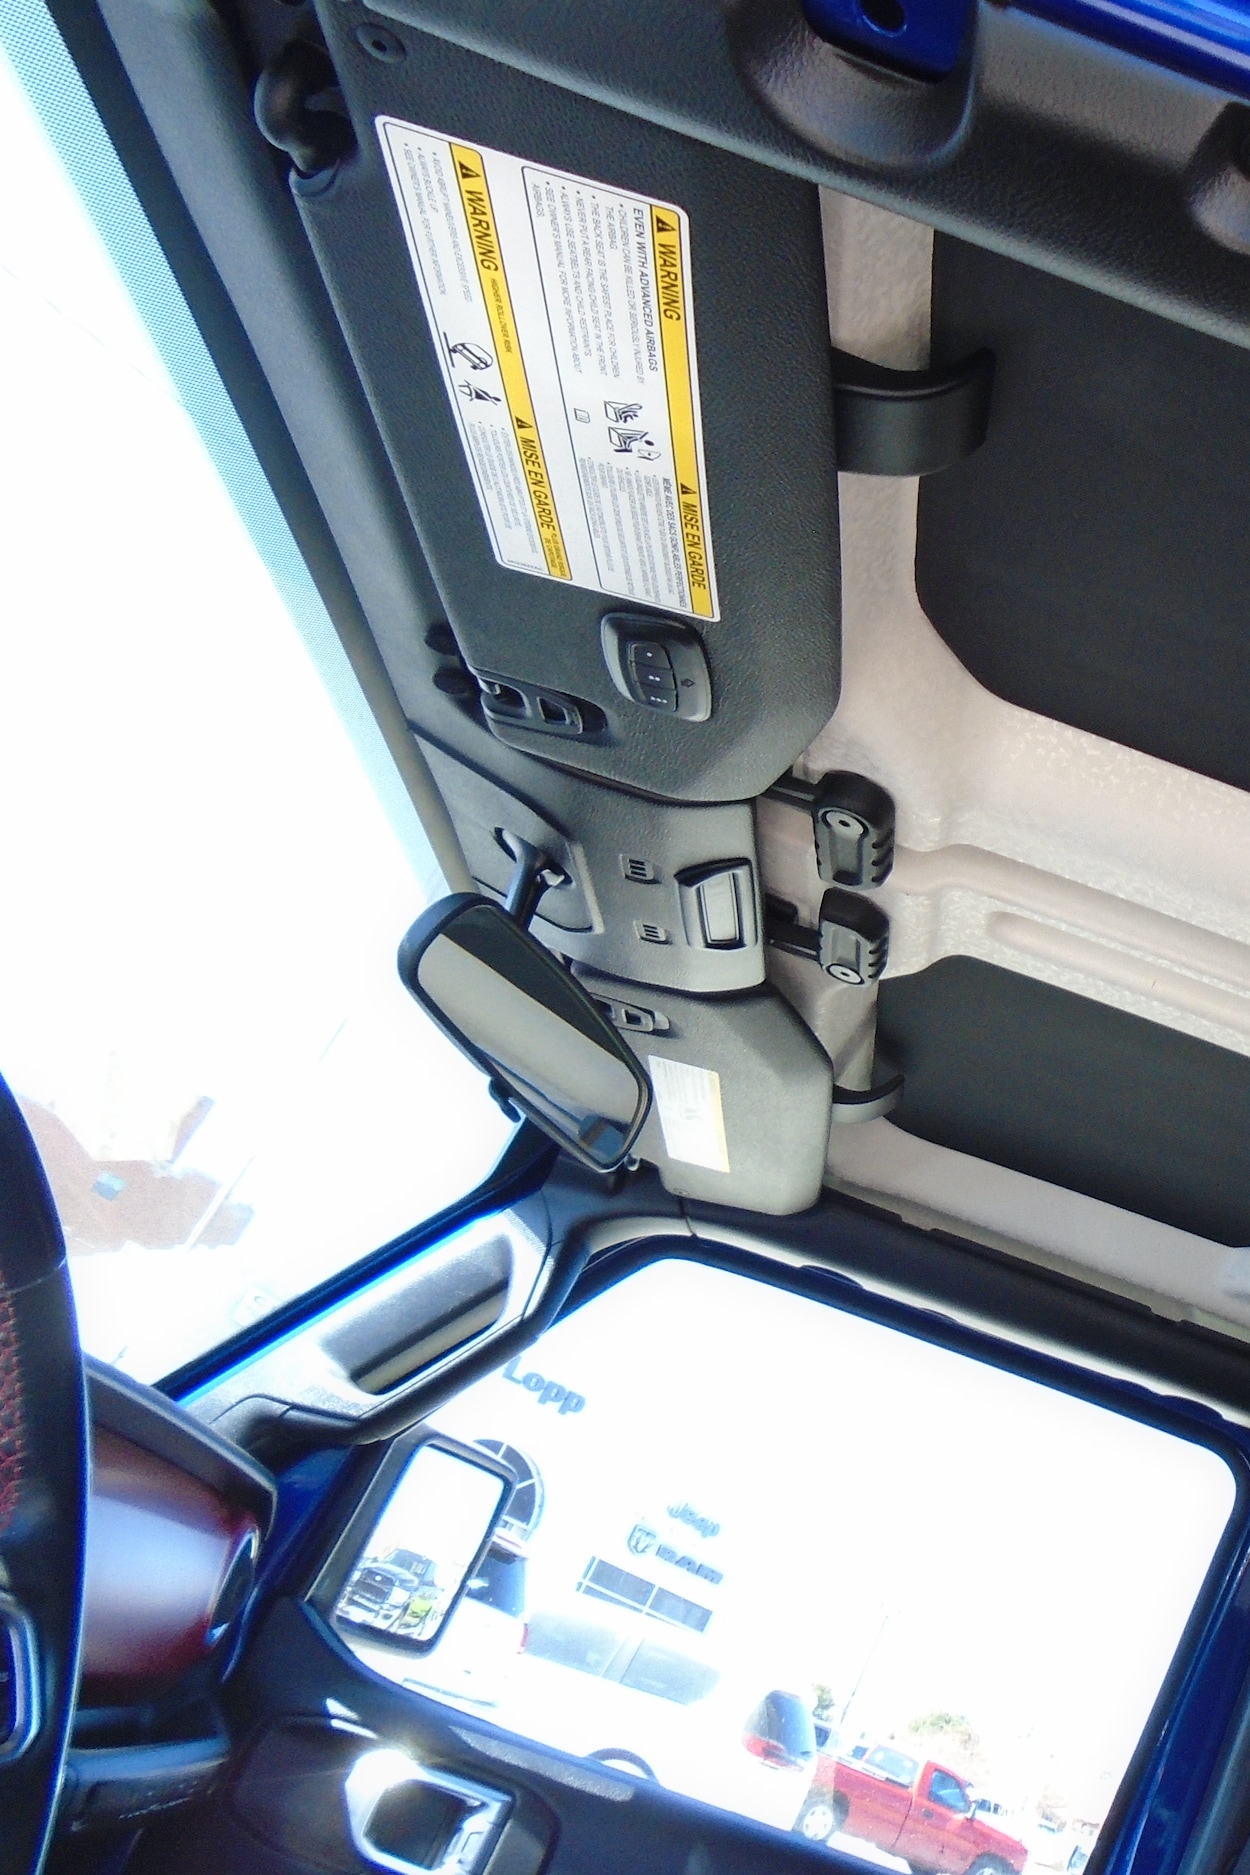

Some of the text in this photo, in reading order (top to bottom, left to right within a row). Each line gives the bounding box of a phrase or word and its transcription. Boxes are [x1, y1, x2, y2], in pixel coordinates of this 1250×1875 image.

[466, 190, 497, 270] WARNING
[491, 278, 501, 303] HIGHER
[496, 304, 509, 338] ROLLOVER
[633, 208, 657, 371] EVEN WITH ADVANCED AIRBAGS
[659, 243, 680, 320] WARNING
[520, 437, 555, 530] MISE EN GARDE
[666, 509, 675, 521] DES
[682, 501, 705, 589] MISE EN GARDE
[502, 1355, 586, 1415] Lopp
[667, 1502, 721, 1538] Jeep
[655, 1544, 724, 1585] RAM
